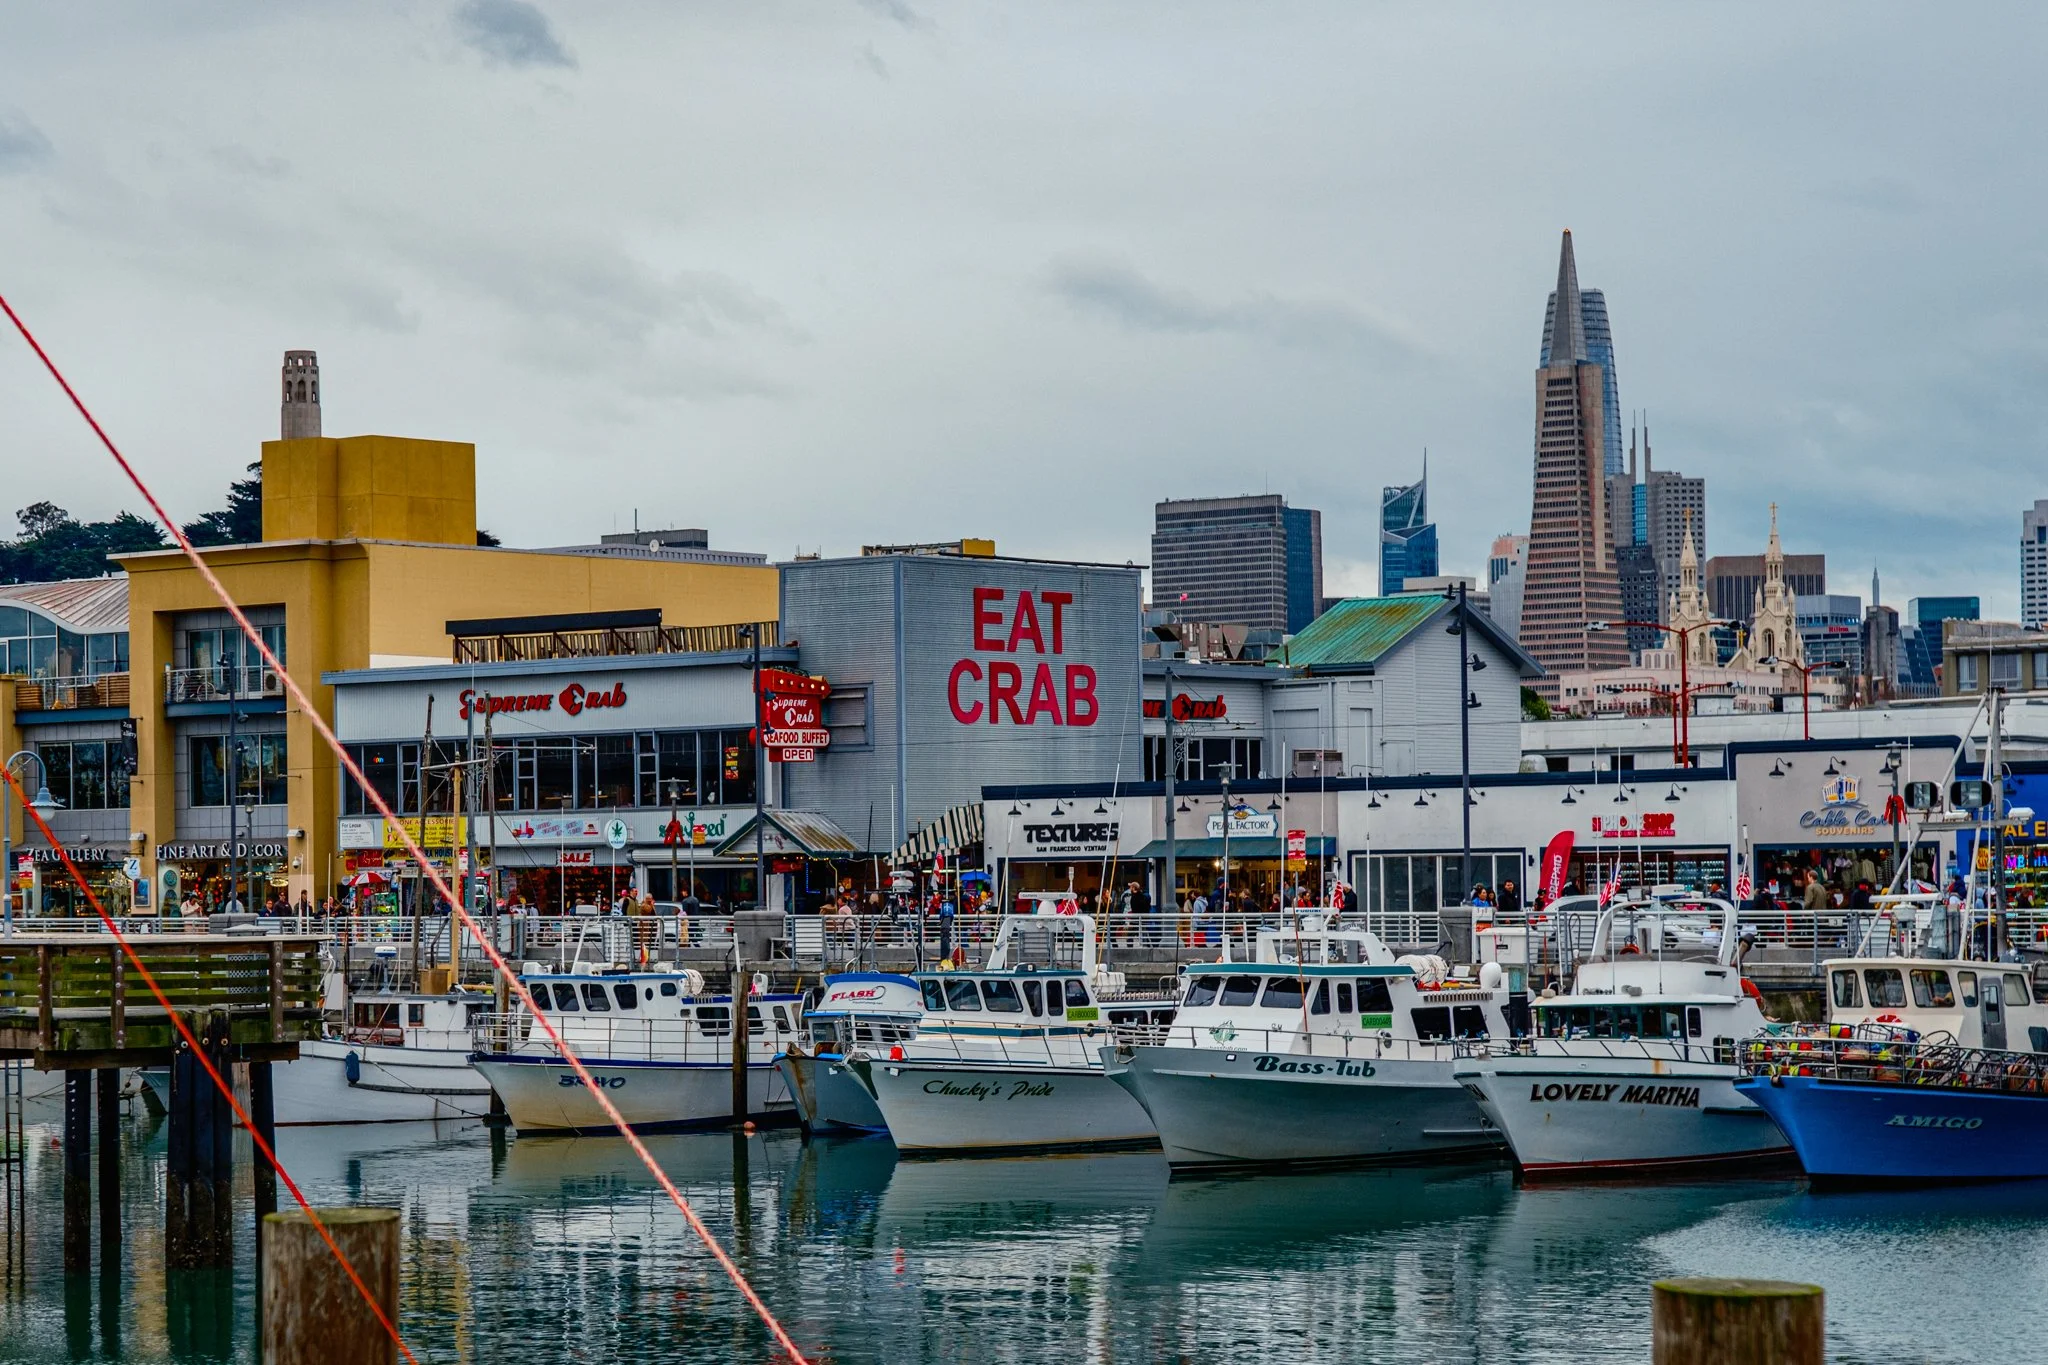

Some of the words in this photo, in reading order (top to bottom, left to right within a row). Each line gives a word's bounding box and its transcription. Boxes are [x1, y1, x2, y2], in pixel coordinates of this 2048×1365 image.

[973, 587, 1073, 655] EAT
[947, 658, 1099, 727] CRAB
[766, 732, 799, 744] SEAFOOD
[801, 732, 828, 744] BUFFET
[784, 749, 813, 760] OPEN
[1236, 820, 1271, 830] FACTORY
[1800, 810, 1848, 827] Cable
[1855, 810, 1888, 826] Car
[1023, 822, 1119, 843] TEXTURES
[1815, 826, 1875, 837] SOUVENIRS
[2003, 824, 2029, 838] AL
[2034, 821, 2048, 837] E
[26, 848, 49, 861] ZEA
[156, 844, 186, 859] FINE
[190, 843, 216, 858] ART
[220, 842, 231, 857] &
[560, 852, 592, 863] SALE
[1050, 845, 1081, 853] FRANCISCO
[1548, 854, 1563, 900] PREPAID
[830, 990, 877, 1002] FLASH
[1253, 1056, 1376, 1077] Bass-Tub
[922, 1080, 1002, 1101] Chucky's
[1008, 1080, 1056, 1101] Pride
[1530, 1084, 1620, 1102] LOVELY
[1619, 1085, 1701, 1108] MARTHA
[1884, 1114, 1983, 1130] AMIGO
